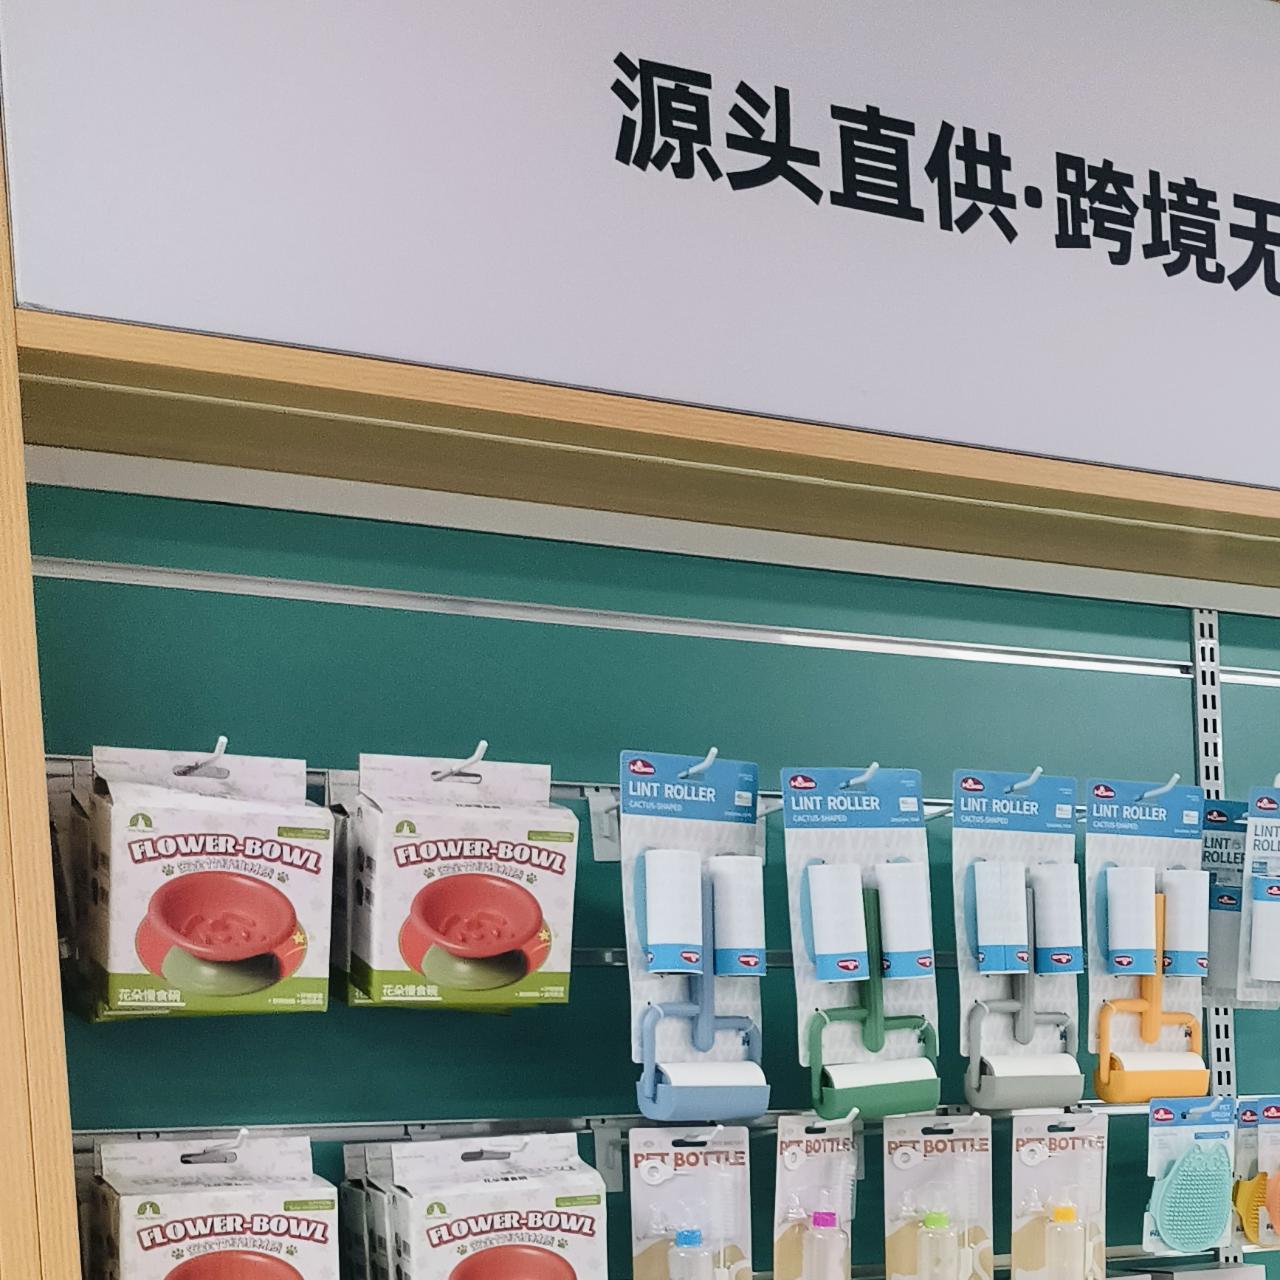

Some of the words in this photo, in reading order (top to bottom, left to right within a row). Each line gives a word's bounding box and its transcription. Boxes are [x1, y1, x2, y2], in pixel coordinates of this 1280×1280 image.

[629, 780, 660, 798] LINT
[664, 783, 716, 802] ROLLER
[791, 796, 823, 811] LINT
[827, 796, 880, 811] ROLLER
[960, 797, 988, 813] LINT
[992, 799, 1039, 815] ROLLER
[1092, 804, 1119, 819] LINT
[1122, 805, 1166, 821] ROLLER
[1204, 836, 1231, 850] LINT
[128, 833, 321, 875] FLOWER-BOWL
[394, 838, 567, 875] FLOWER-BOWL
[923, 1138, 989, 1154] BOTTLE
[674, 1151, 745, 1168] BOTTLE
[137, 1213, 330, 1251] FLOWER-BOWL
[425, 1210, 596, 1248] FLOWER-BOWL
